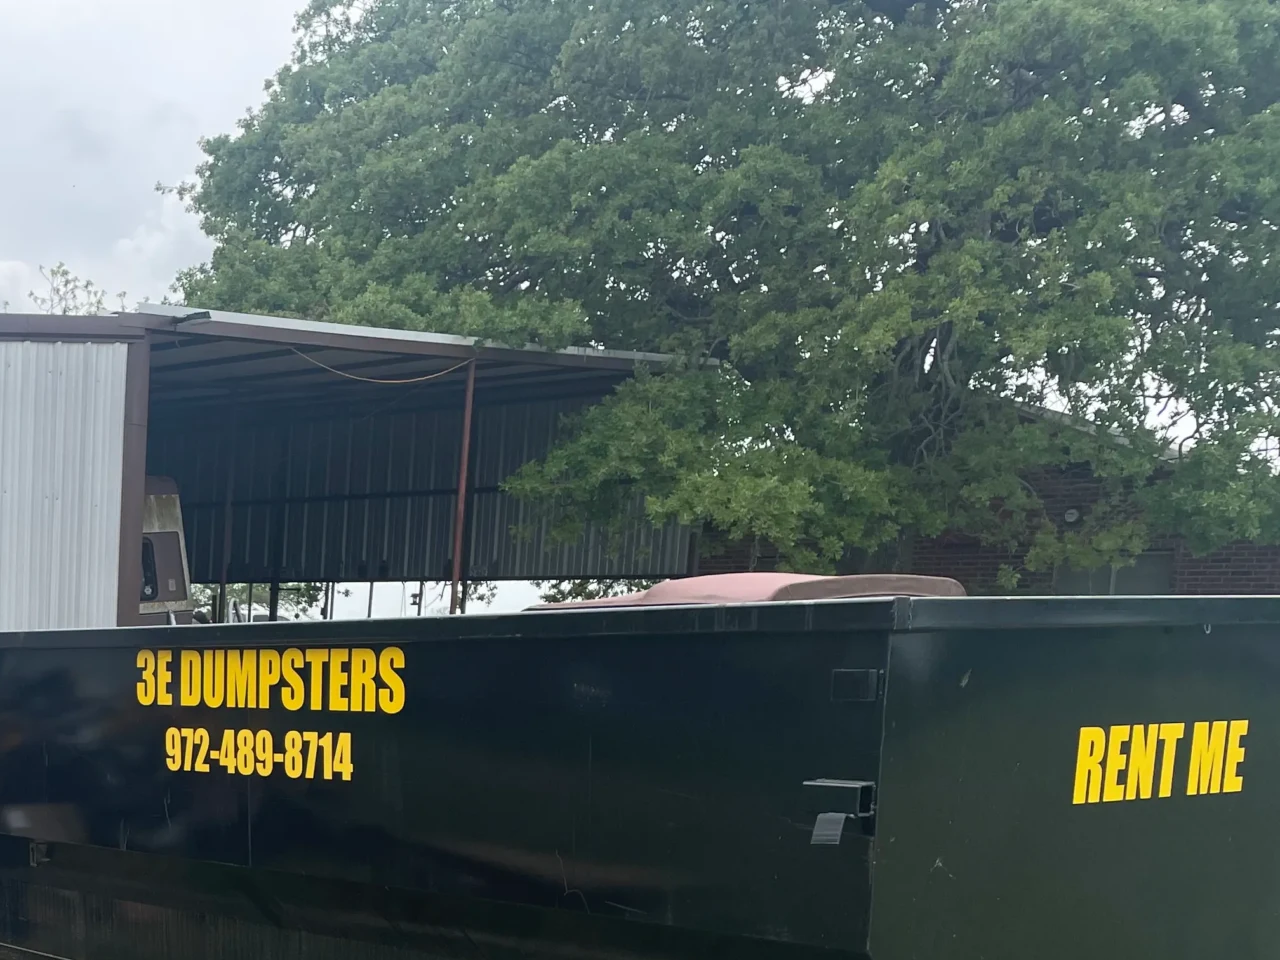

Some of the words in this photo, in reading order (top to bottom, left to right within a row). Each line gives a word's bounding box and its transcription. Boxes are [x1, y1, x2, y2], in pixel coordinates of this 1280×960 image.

[136, 649, 173, 706] 3E
[180, 647, 406, 714] DUMPSTERS
[165, 727, 354, 781] 972-489-8714
[1072, 722, 1185, 805] RENT
[1186, 719, 1249, 796] ME
